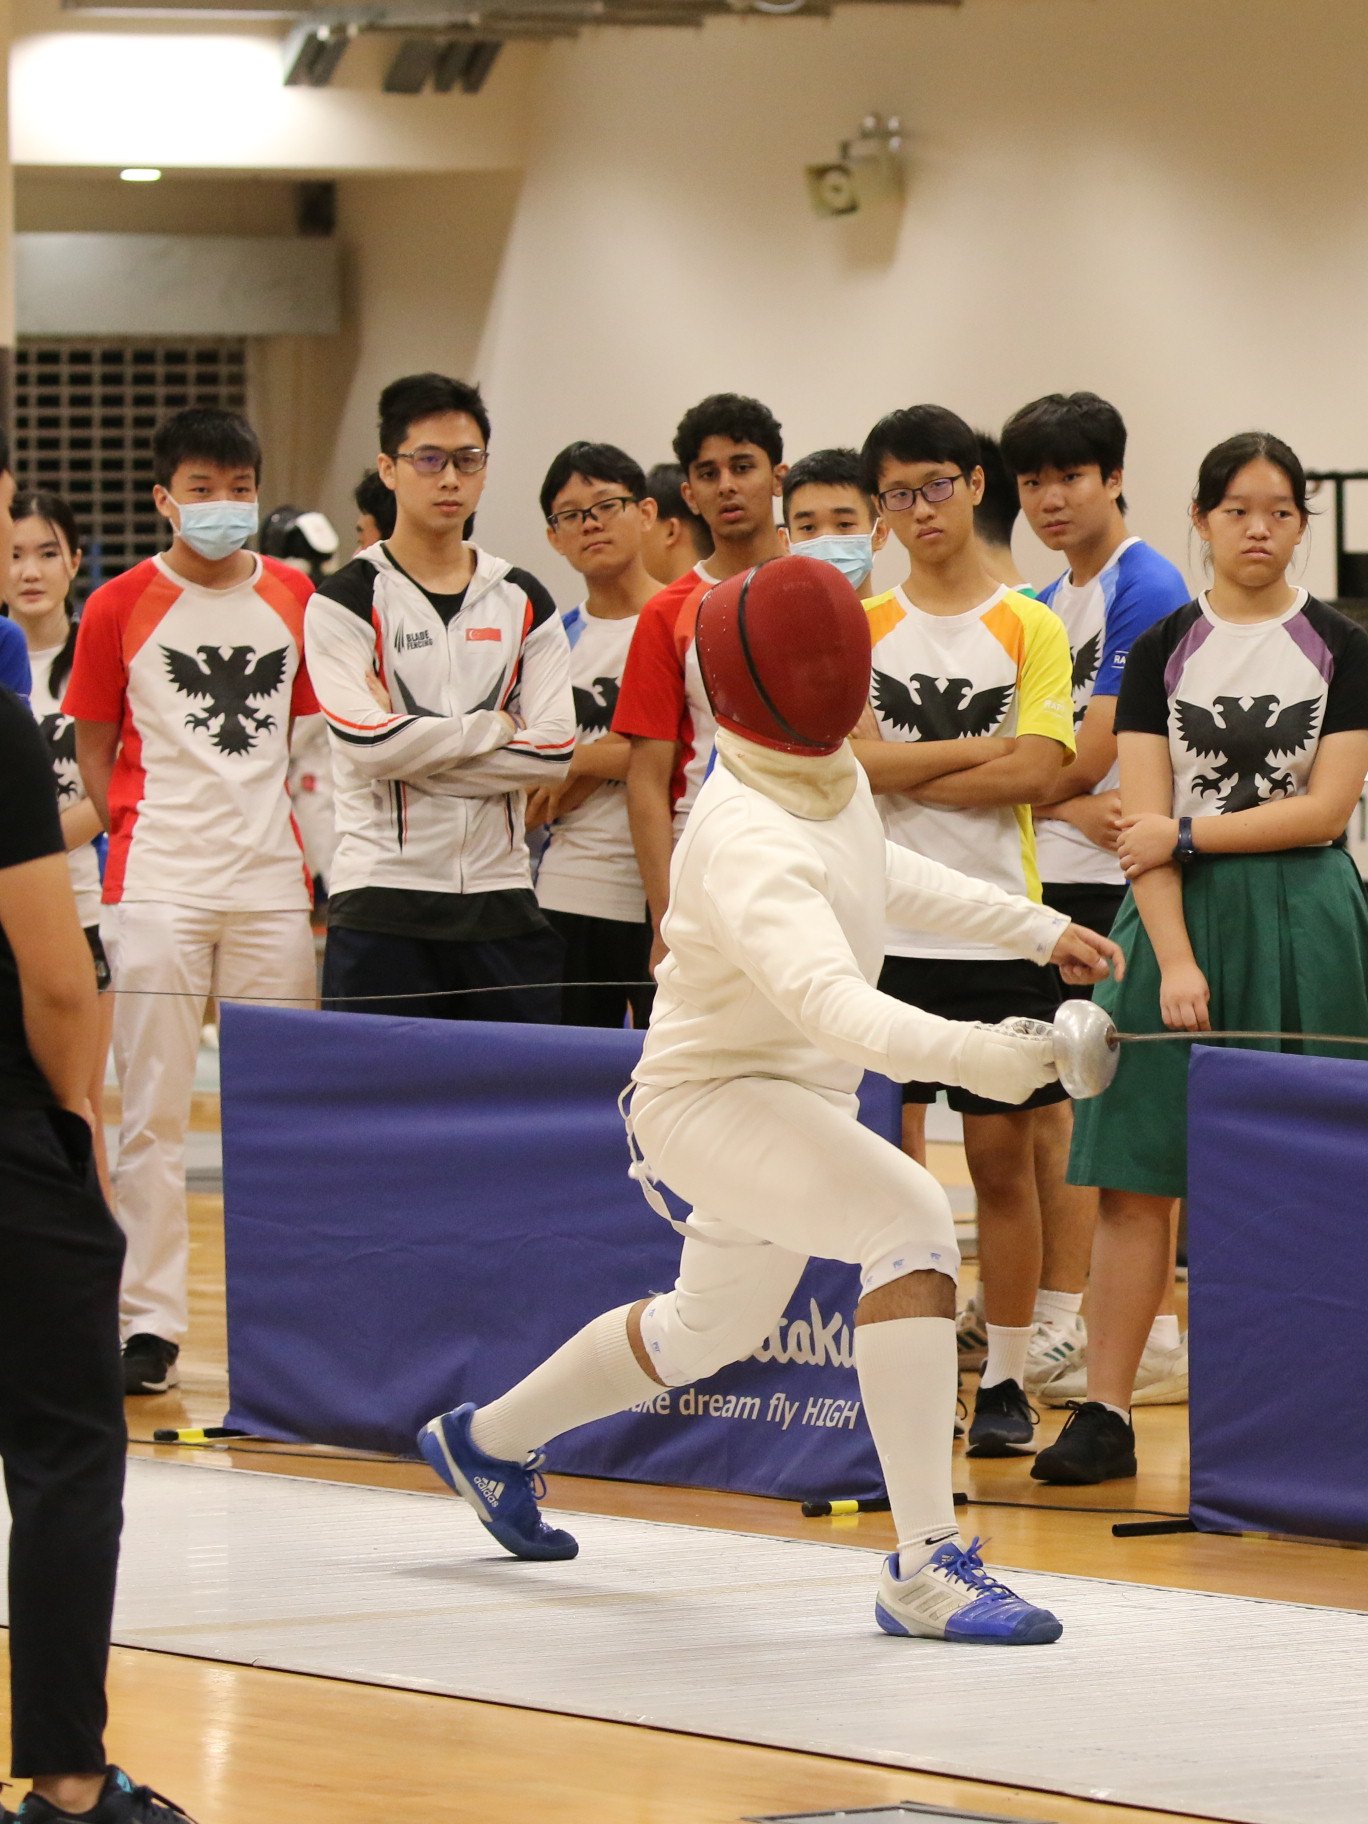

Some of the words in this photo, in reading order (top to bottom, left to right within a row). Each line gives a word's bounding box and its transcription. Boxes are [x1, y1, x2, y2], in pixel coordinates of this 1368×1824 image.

[406, 630, 430, 642] BLADE
[679, 1388, 761, 1420] dream
[766, 1392, 800, 1431] fly
[802, 1397, 861, 1430] HIGH
[473, 1476, 499, 1508] adidas
